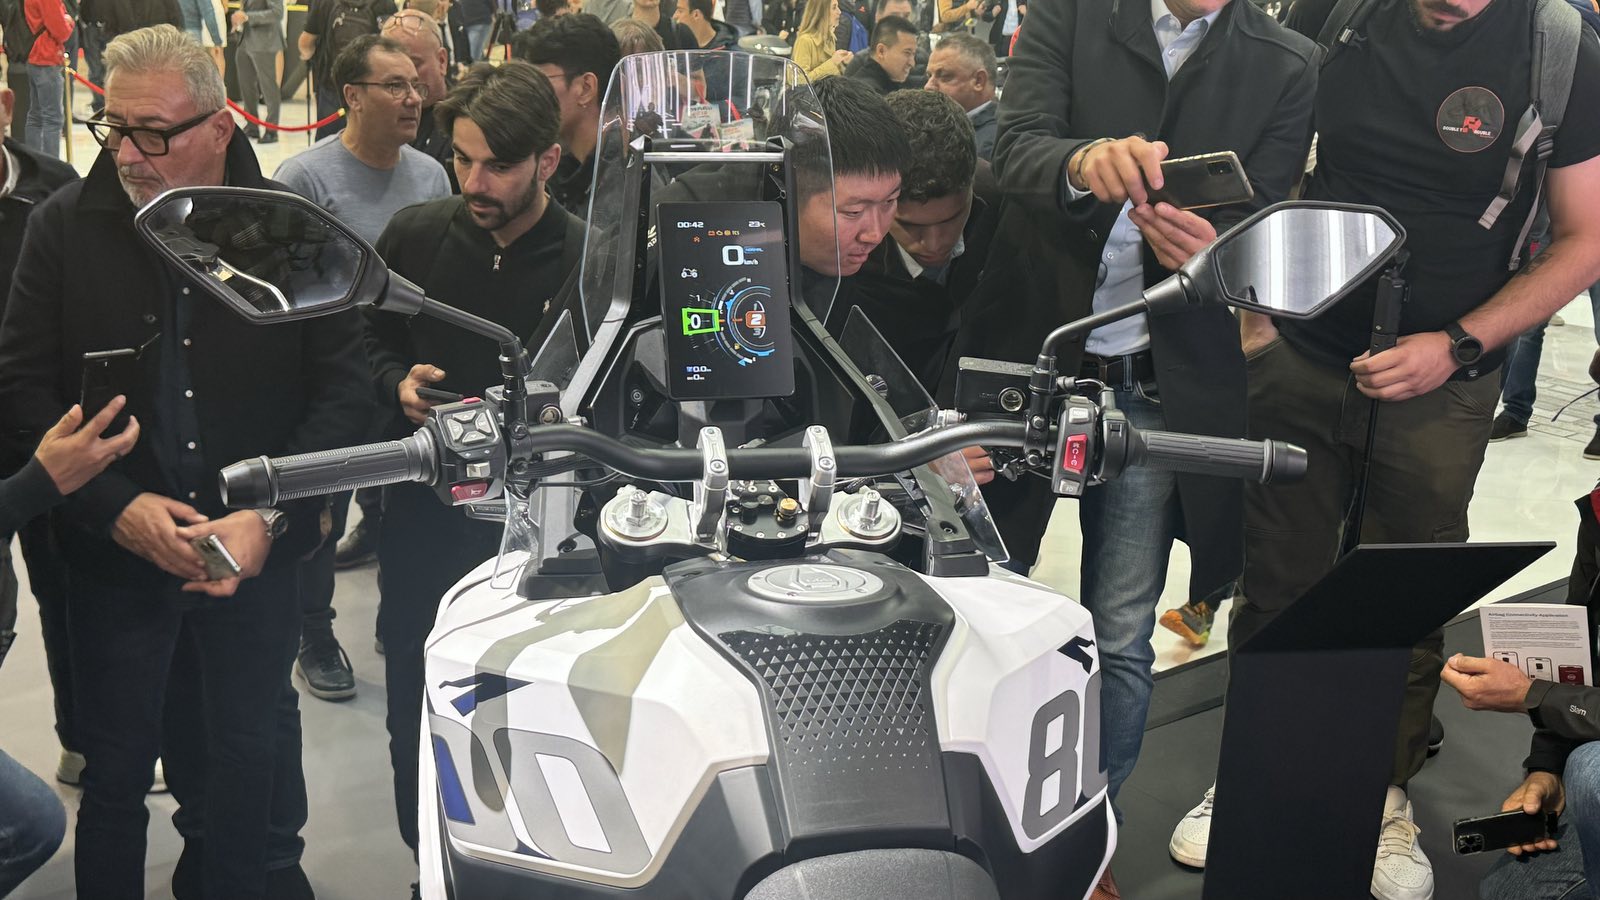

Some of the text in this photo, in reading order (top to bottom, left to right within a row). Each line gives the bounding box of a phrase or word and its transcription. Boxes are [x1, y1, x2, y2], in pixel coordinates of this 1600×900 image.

[722, 245, 744, 266] 0
[696, 294, 701, 302] 1
[690, 314, 702, 329] 0
[750, 313, 762, 325] 2
[753, 328, 762, 336] 3
[1569, 704, 1587, 717] Slam
